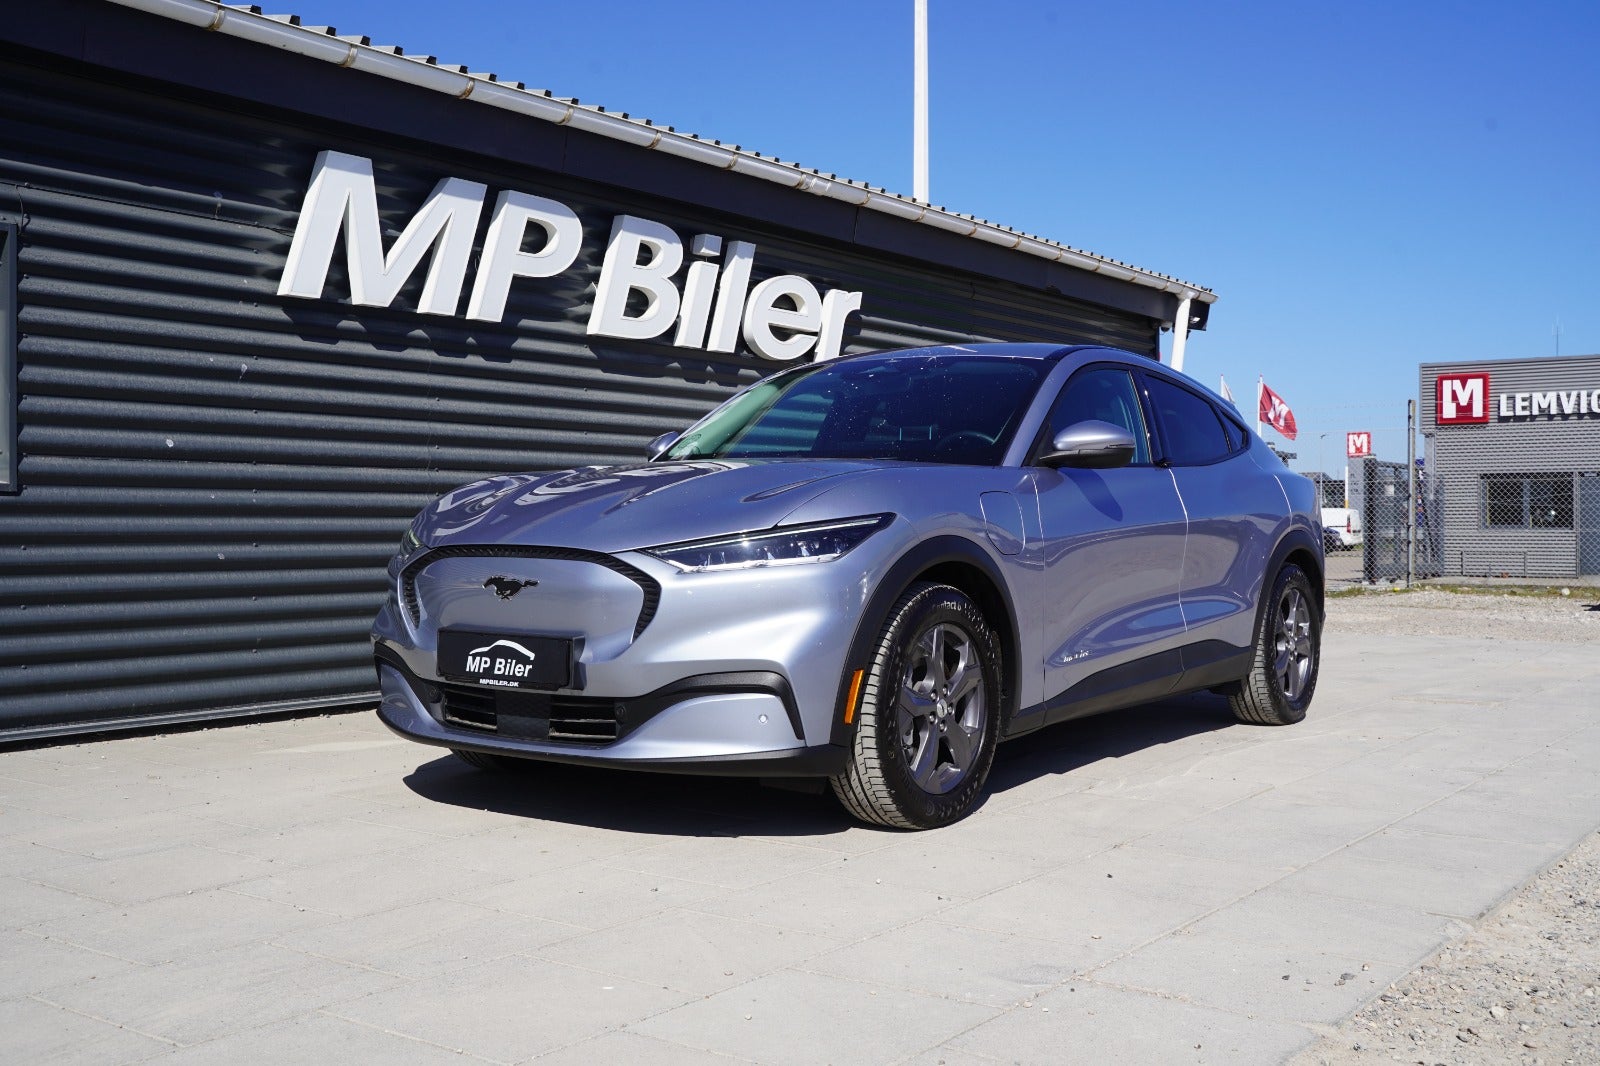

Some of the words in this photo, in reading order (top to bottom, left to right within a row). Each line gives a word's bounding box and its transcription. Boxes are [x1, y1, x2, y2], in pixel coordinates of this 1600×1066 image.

[277, 150, 583, 323] MP
[587, 214, 863, 363] Biler
[465, 655, 491, 673] MP
[493, 657, 533, 678] Biler
[479, 678, 520, 687] MPBILER.DK
